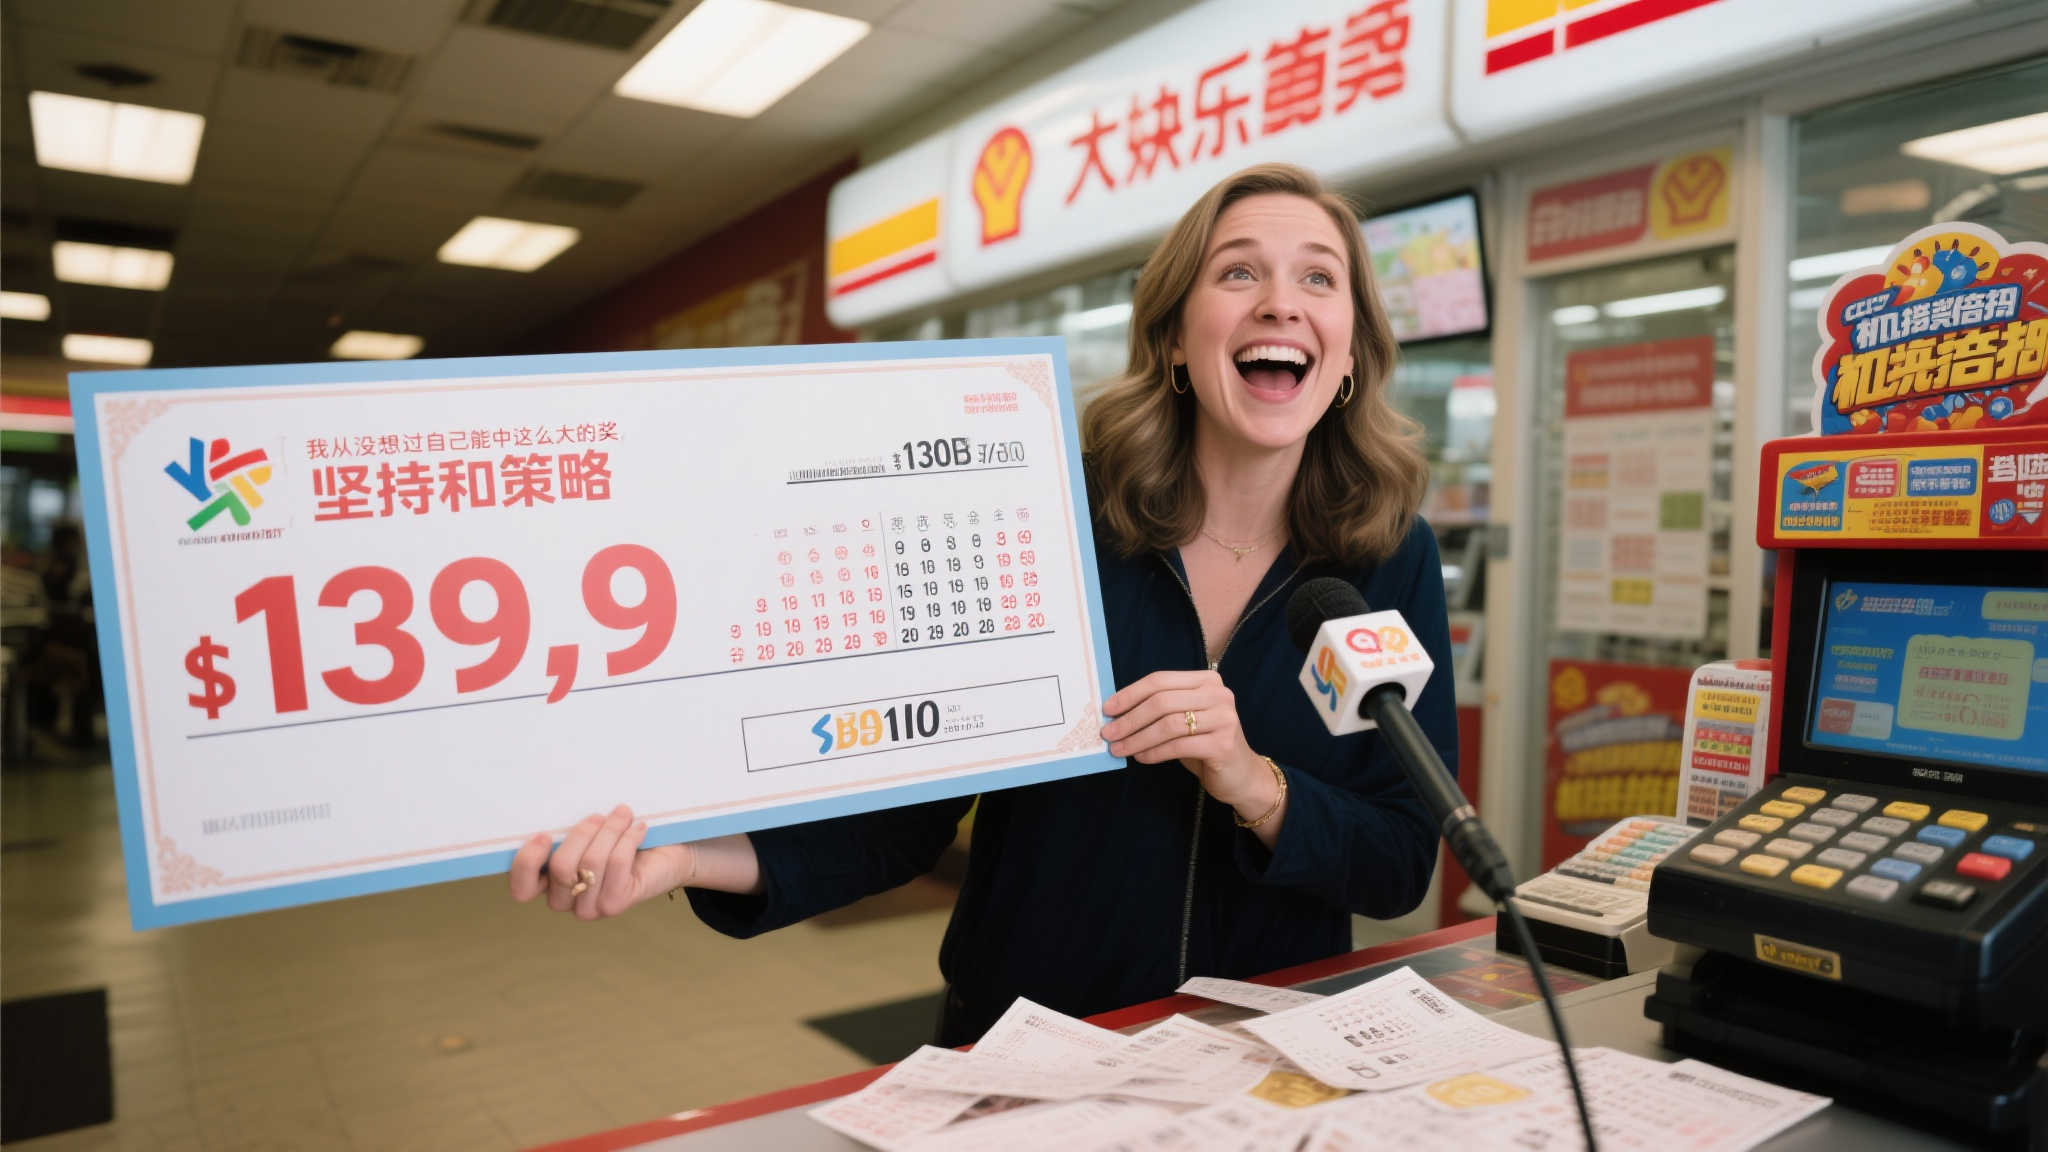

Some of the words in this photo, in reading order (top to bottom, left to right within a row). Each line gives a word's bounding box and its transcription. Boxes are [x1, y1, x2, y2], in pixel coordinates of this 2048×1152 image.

[311, 448, 612, 521] 坚持和策略
[184, 543, 678, 720] $139,9
